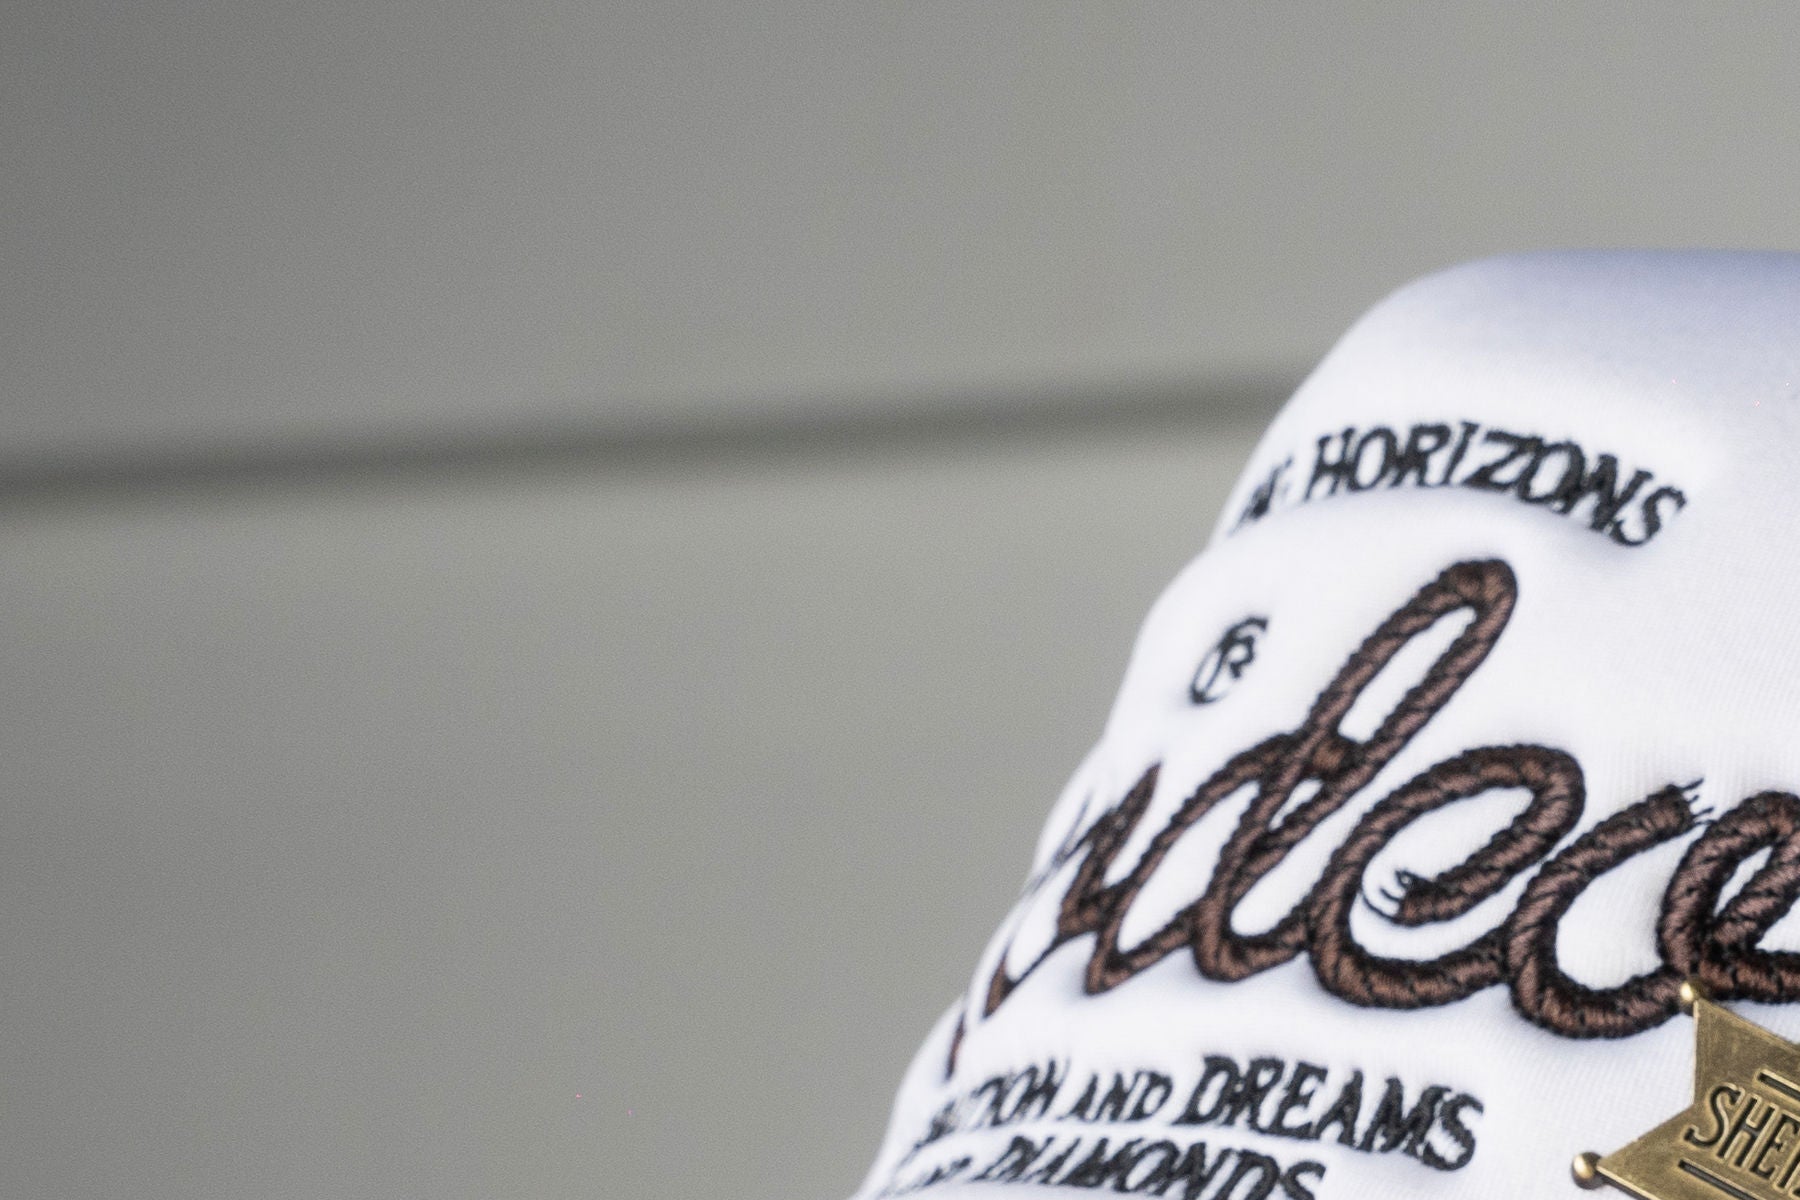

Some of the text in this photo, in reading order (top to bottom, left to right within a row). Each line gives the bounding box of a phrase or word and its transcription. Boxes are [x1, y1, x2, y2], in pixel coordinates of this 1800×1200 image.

[1304, 420, 1688, 548] HORIZONS
[1055, 1070, 1176, 1125] AND
[1172, 1054, 1485, 1172] DREAMS
